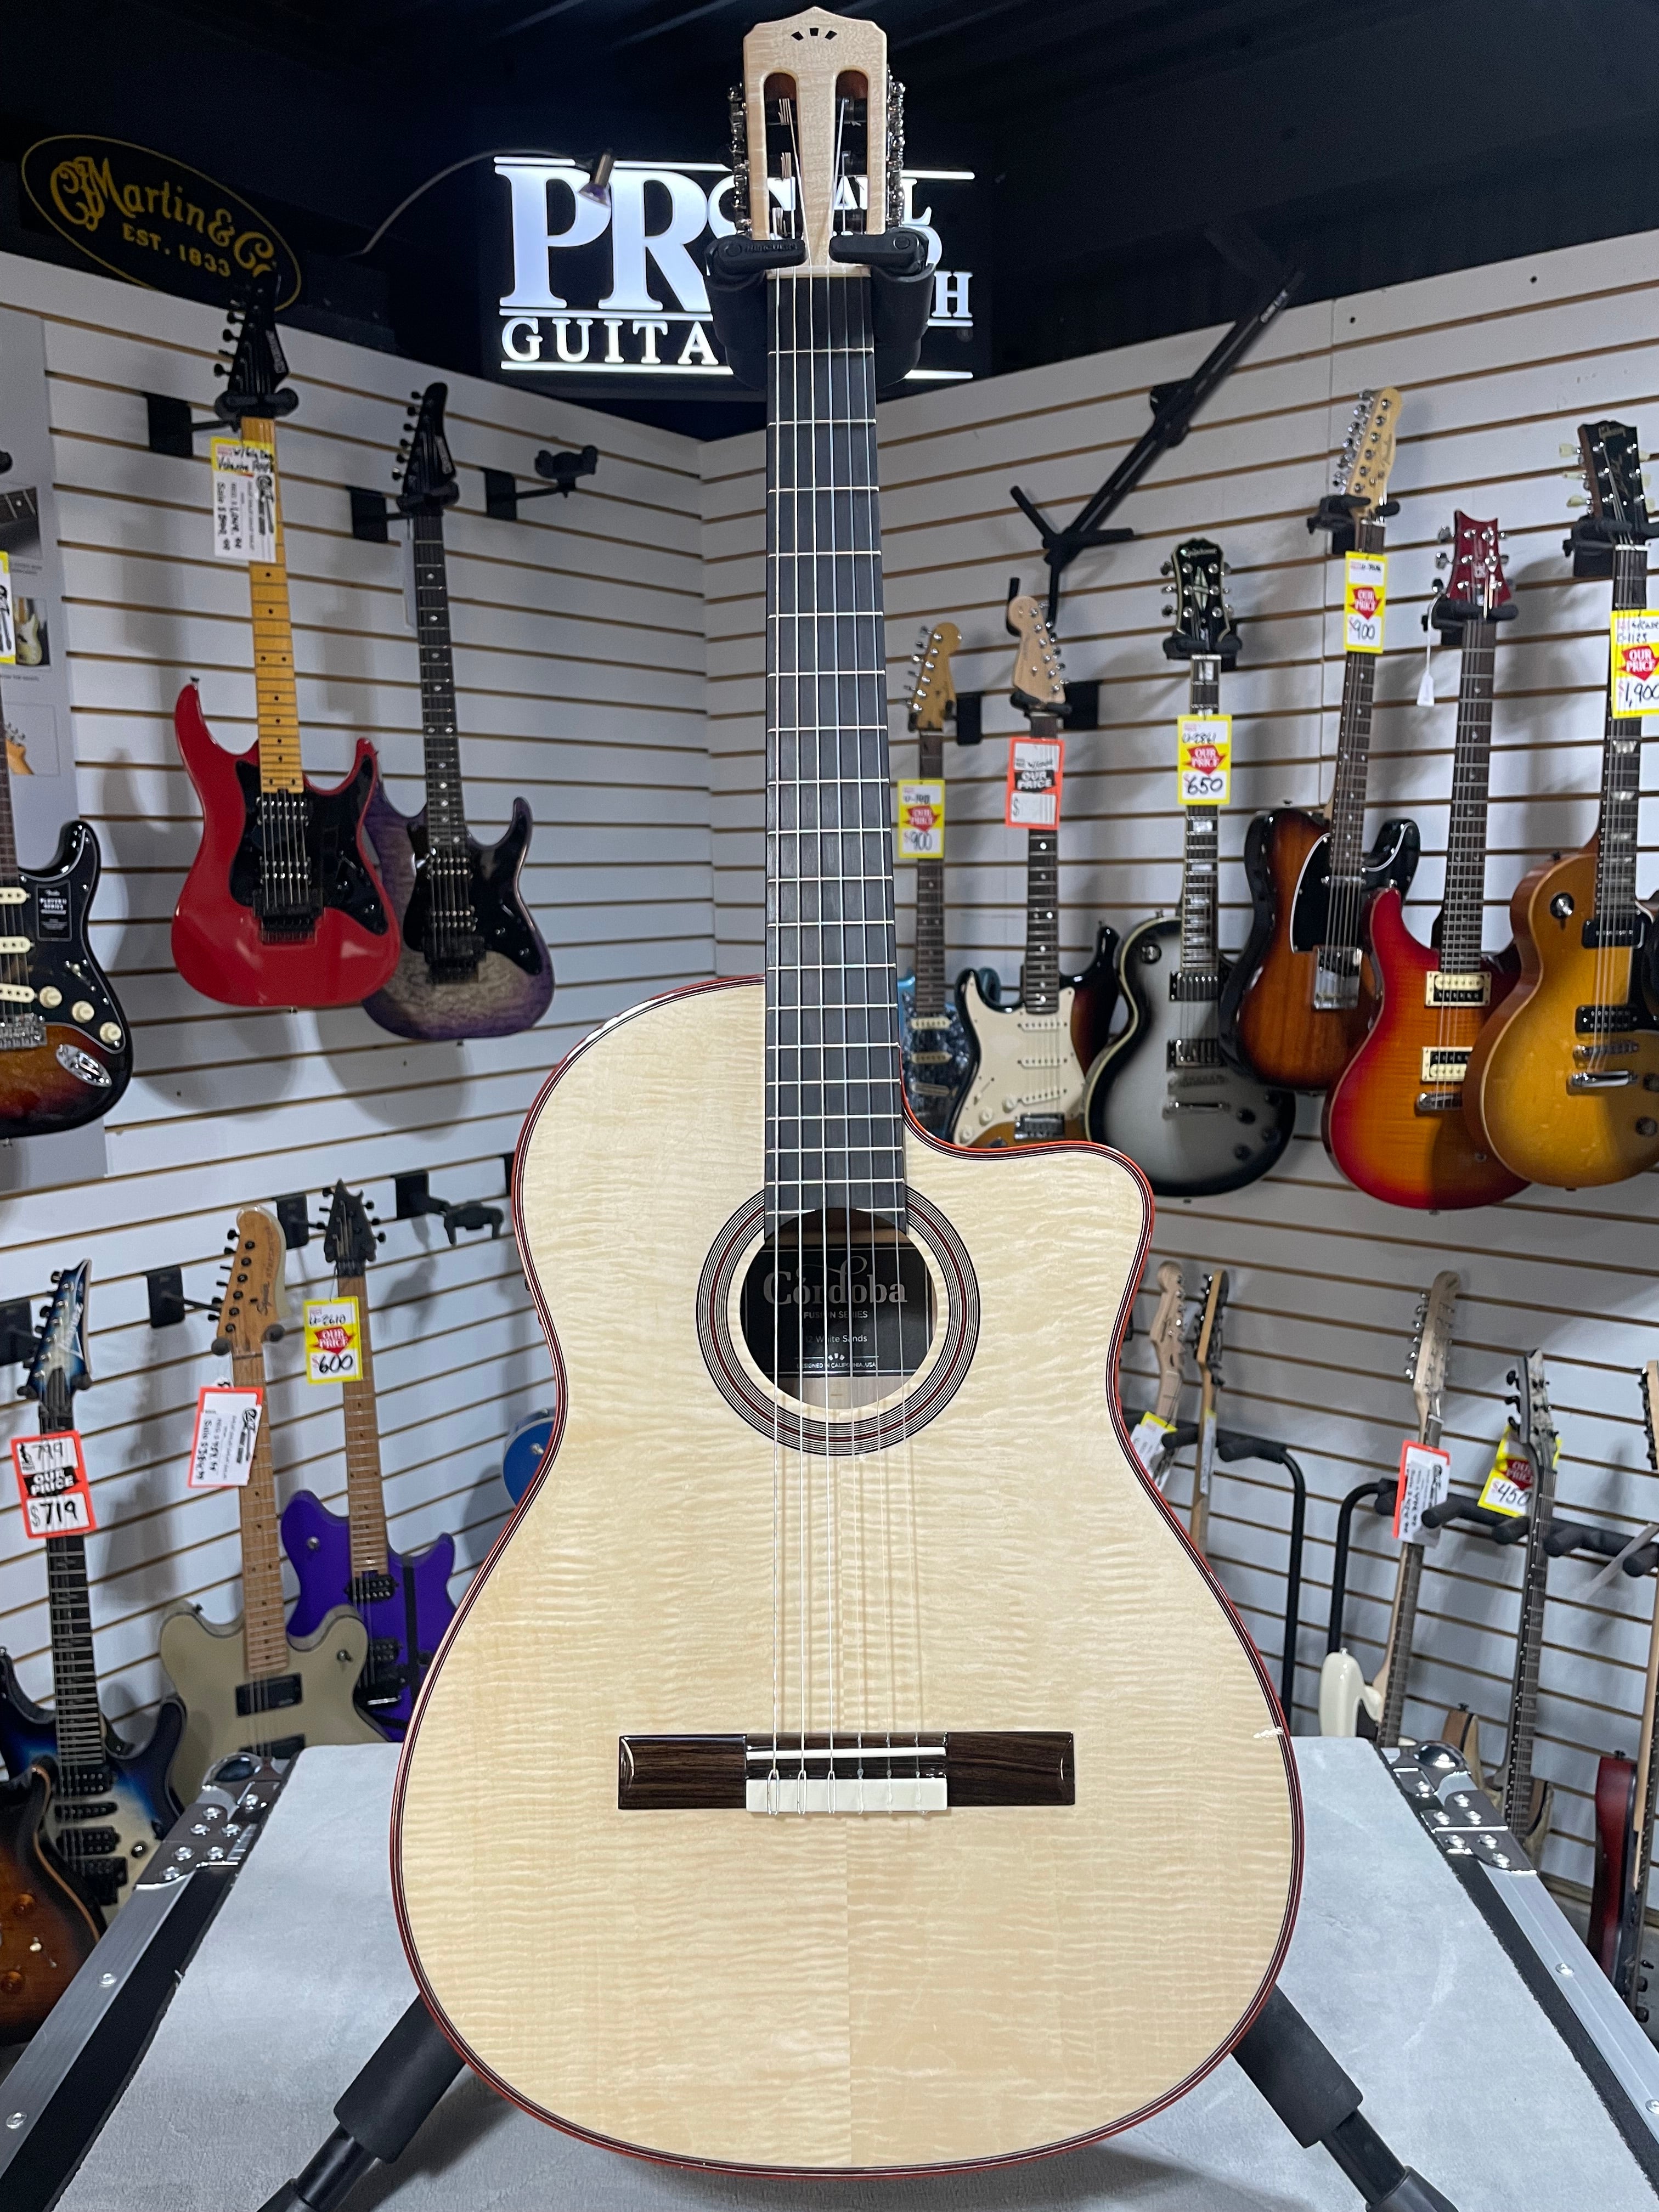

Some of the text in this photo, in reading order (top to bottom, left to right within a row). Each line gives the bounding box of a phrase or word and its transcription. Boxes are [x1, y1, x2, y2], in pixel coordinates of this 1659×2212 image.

[501, 317, 719, 366] GUITA
[1629, 648, 1652, 661] OUR
[1626, 659, 1656, 673] PRICE
[1022, 770, 1047, 781] OUR
[1188, 776, 1223, 795] 650
[803, 1311, 836, 1319] FUSIN
[322, 1328, 345, 1339] OUR
[319, 1336, 348, 1349] PRICE
[33, 1468, 65, 1485] OUR
[30, 1474, 75, 1497] PRICE
